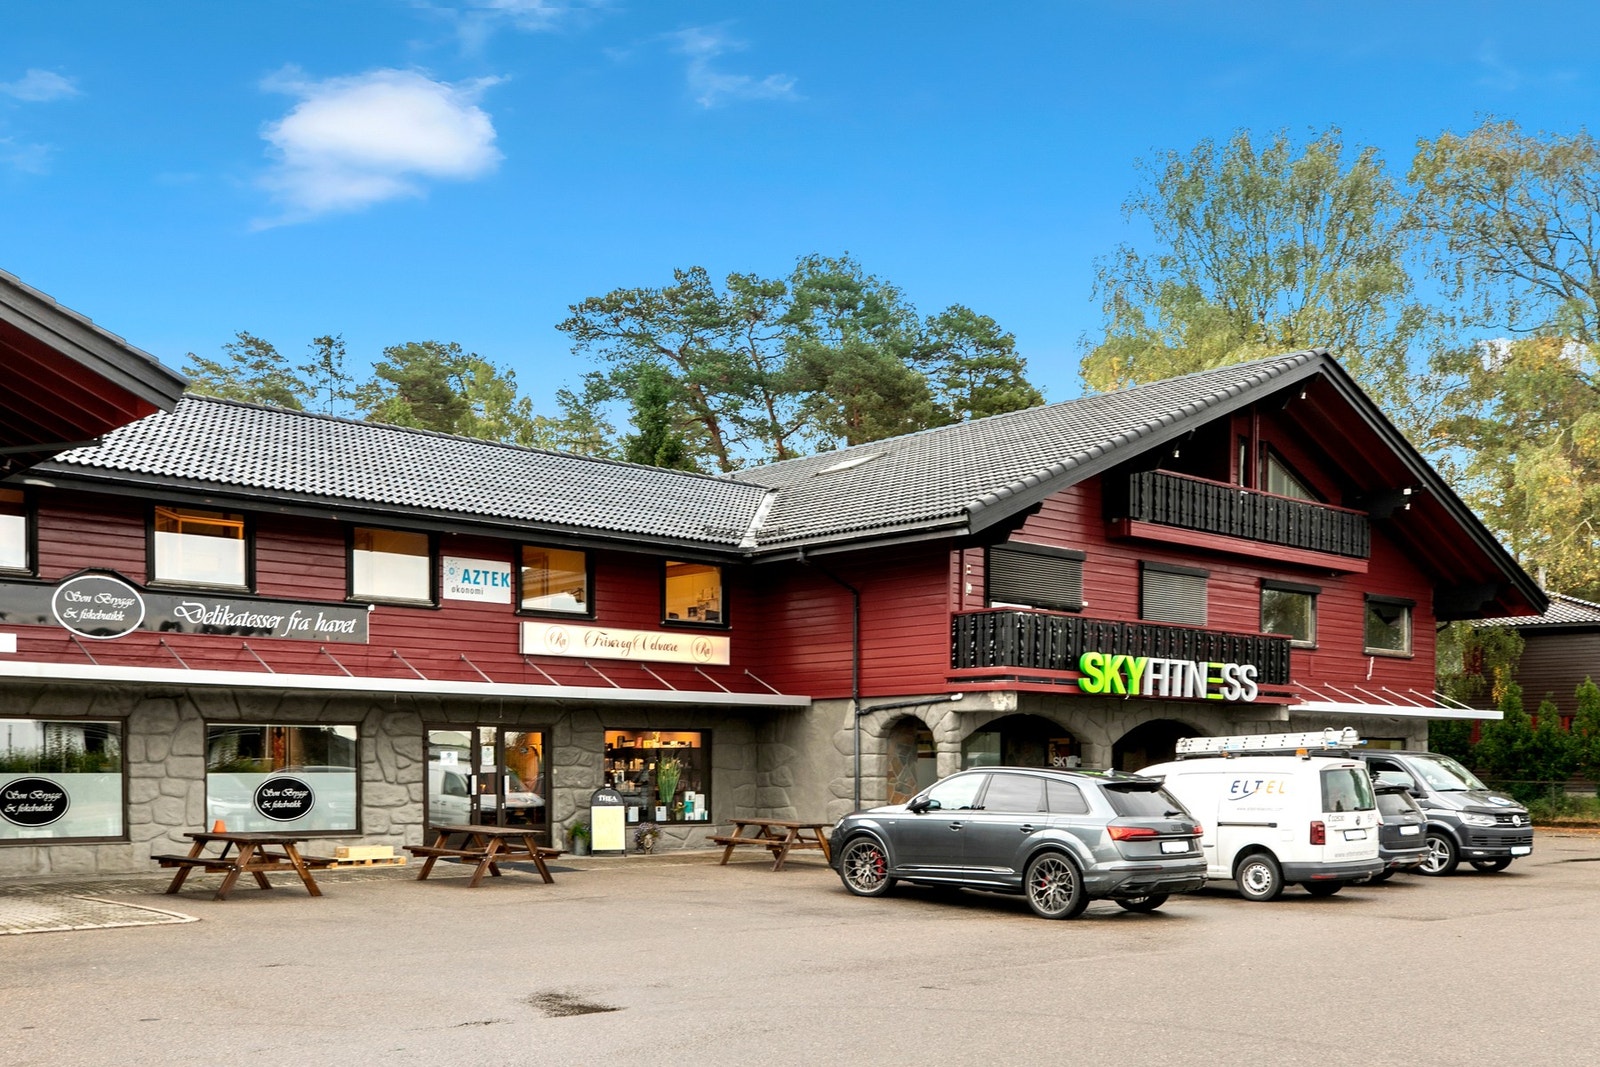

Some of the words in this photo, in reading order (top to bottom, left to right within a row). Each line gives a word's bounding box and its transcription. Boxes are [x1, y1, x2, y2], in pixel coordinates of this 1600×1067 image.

[461, 568, 510, 588] AZTEK
[94, 592, 136, 609] Brygge
[63, 607, 79, 619] &
[174, 600, 285, 629] Delikatesser
[280, 609, 312, 637] fra
[314, 612, 357, 634] havet
[1230, 780, 1285, 794] ELTEL
